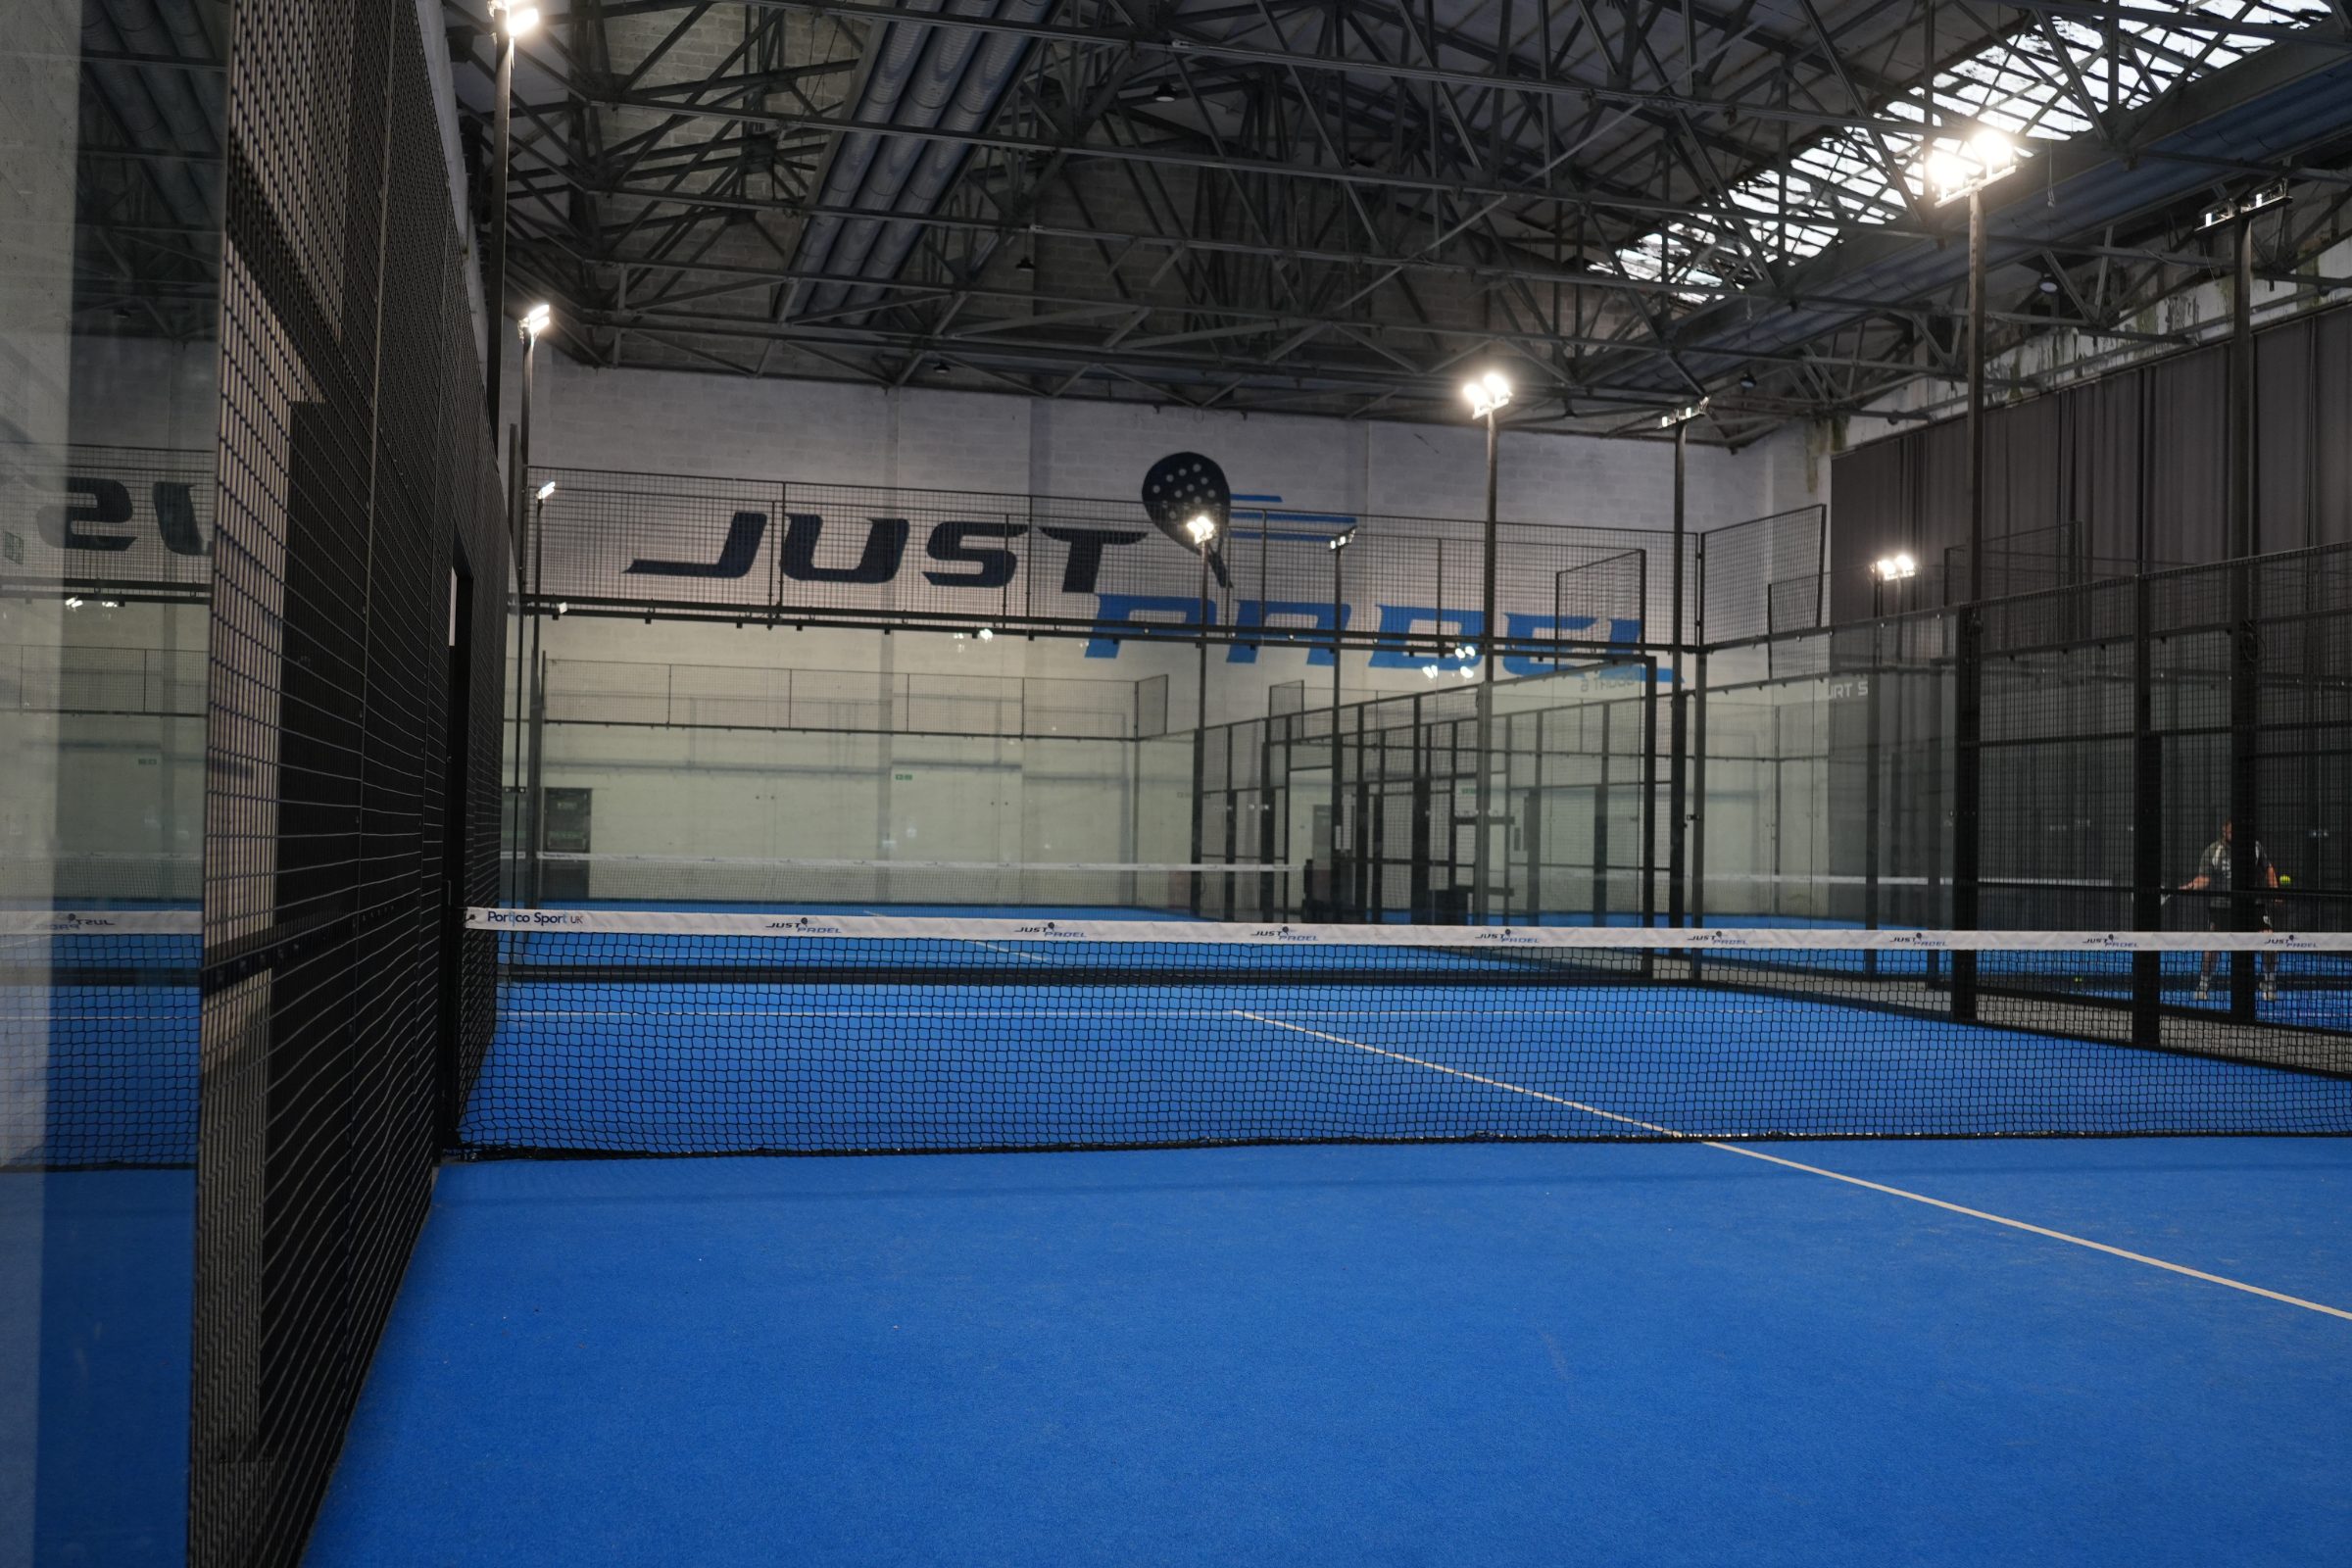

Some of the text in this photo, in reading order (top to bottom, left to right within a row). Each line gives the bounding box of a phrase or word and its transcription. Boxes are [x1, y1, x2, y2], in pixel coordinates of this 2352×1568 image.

[622, 511, 1149, 594] JUST
[1084, 593, 1686, 684] PADEL
[487, 910, 583, 927] Portico Sport UK
